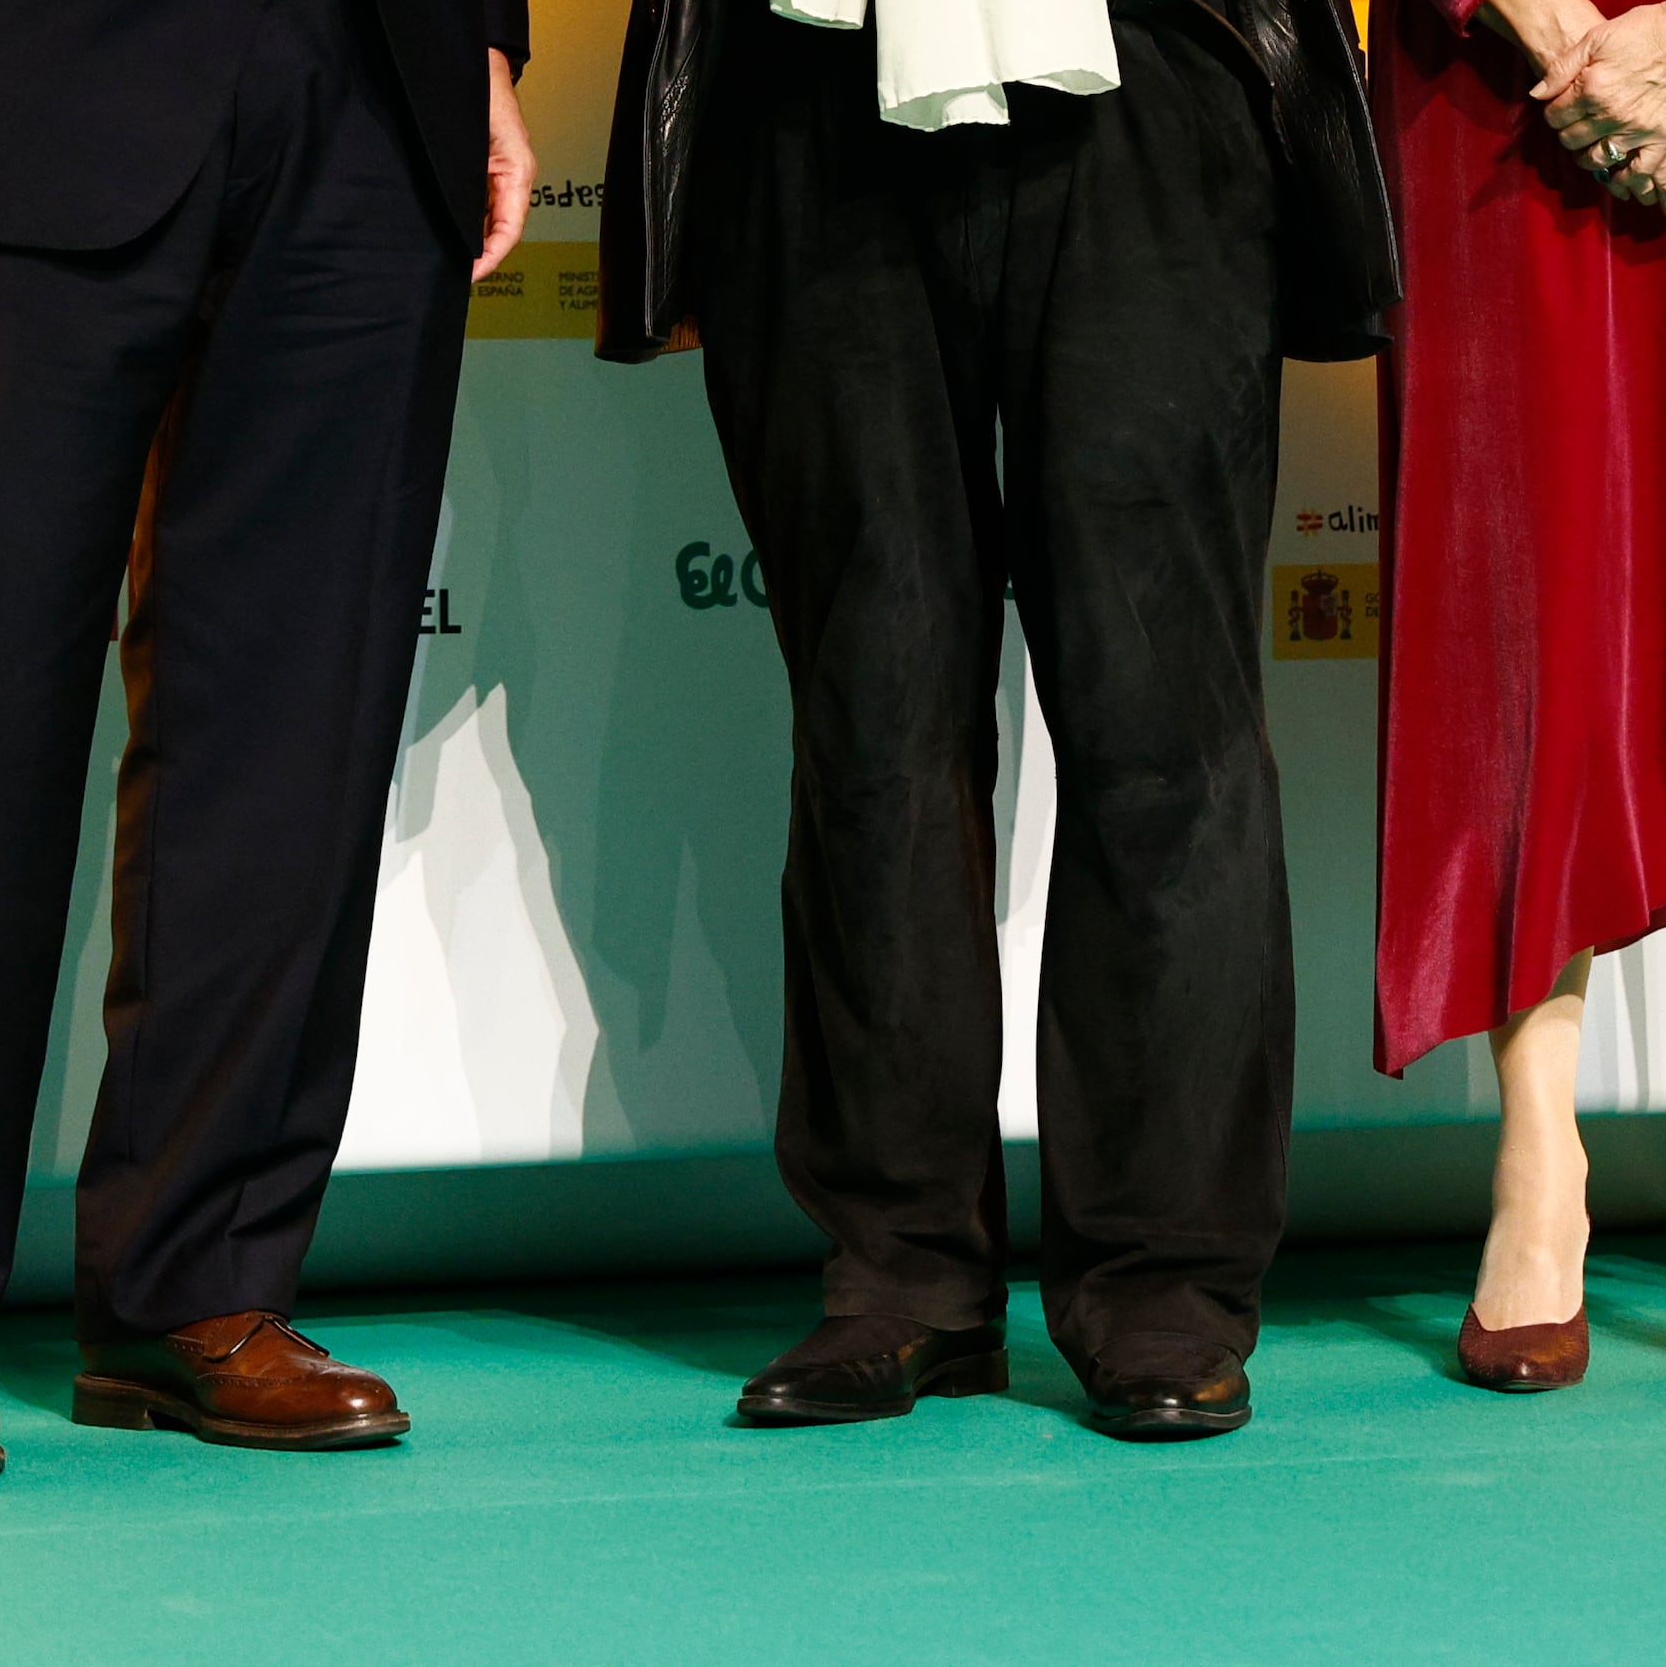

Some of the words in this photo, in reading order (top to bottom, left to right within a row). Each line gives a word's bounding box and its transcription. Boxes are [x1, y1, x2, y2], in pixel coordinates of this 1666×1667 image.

[559, 271, 598, 282] MINIST
[559, 286, 573, 296] DE
[675, 541, 738, 609] El
